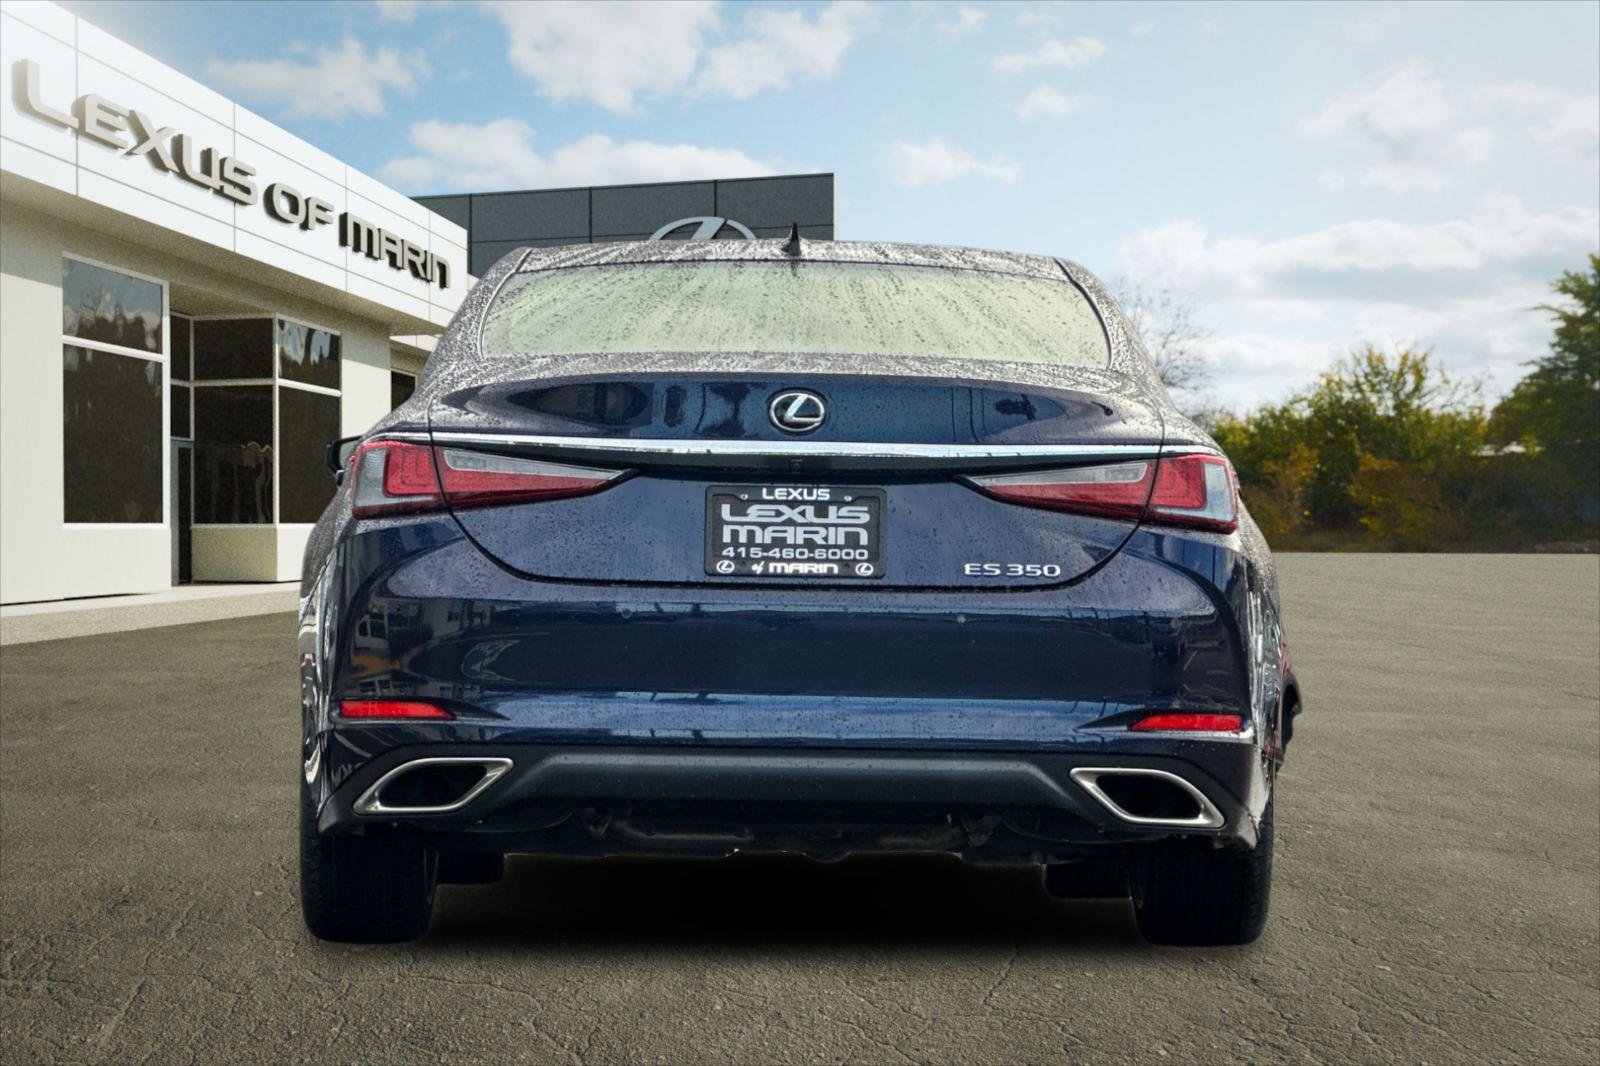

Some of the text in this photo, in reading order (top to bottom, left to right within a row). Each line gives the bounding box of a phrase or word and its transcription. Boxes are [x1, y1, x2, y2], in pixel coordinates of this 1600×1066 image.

[11, 58, 451, 289] LEXUS OF MARIN
[762, 487, 830, 501] LEXUS
[721, 503, 871, 524] LEXUS
[722, 524, 869, 546] MARIN
[722, 546, 869, 560] 415-460-6000
[768, 562, 839, 574] MARIN
[964, 563, 1061, 577] ES 350
